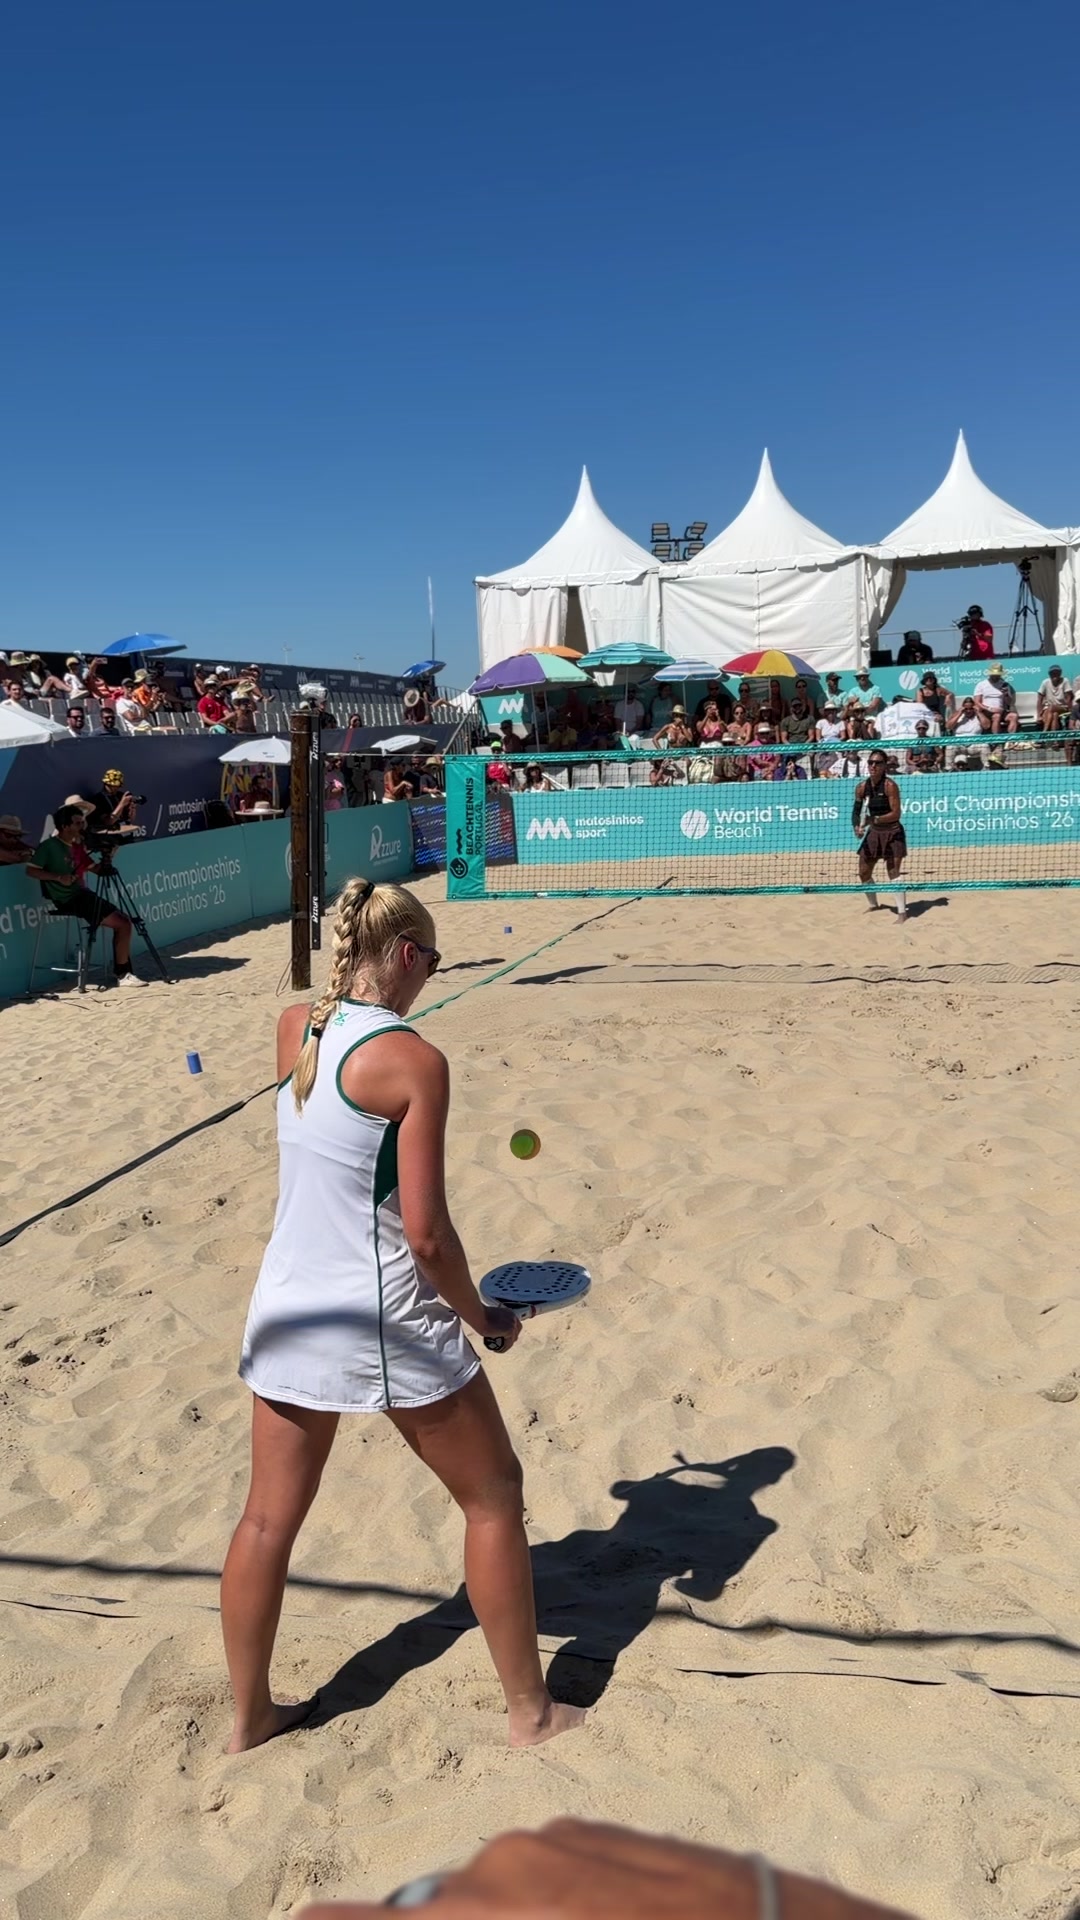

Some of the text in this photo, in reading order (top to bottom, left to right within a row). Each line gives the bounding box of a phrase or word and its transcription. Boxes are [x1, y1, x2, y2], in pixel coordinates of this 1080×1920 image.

[958, 666, 1041, 677] World Cpionships
[168, 797, 208, 816] matosinh
[953, 790, 1080, 812] Championsh
[465, 777, 474, 856] BEACHTENNIS
[575, 814, 644, 827] matosinhos
[714, 801, 839, 824] World Tennis
[167, 817, 193, 834] sport
[474, 800, 484, 856] PORTUGAL
[714, 823, 763, 839] Beach
[926, 813, 1040, 833] Matosinhos
[575, 827, 607, 840] sport
[154, 856, 241, 893] Championships
[139, 892, 209, 923] Matosinhos
